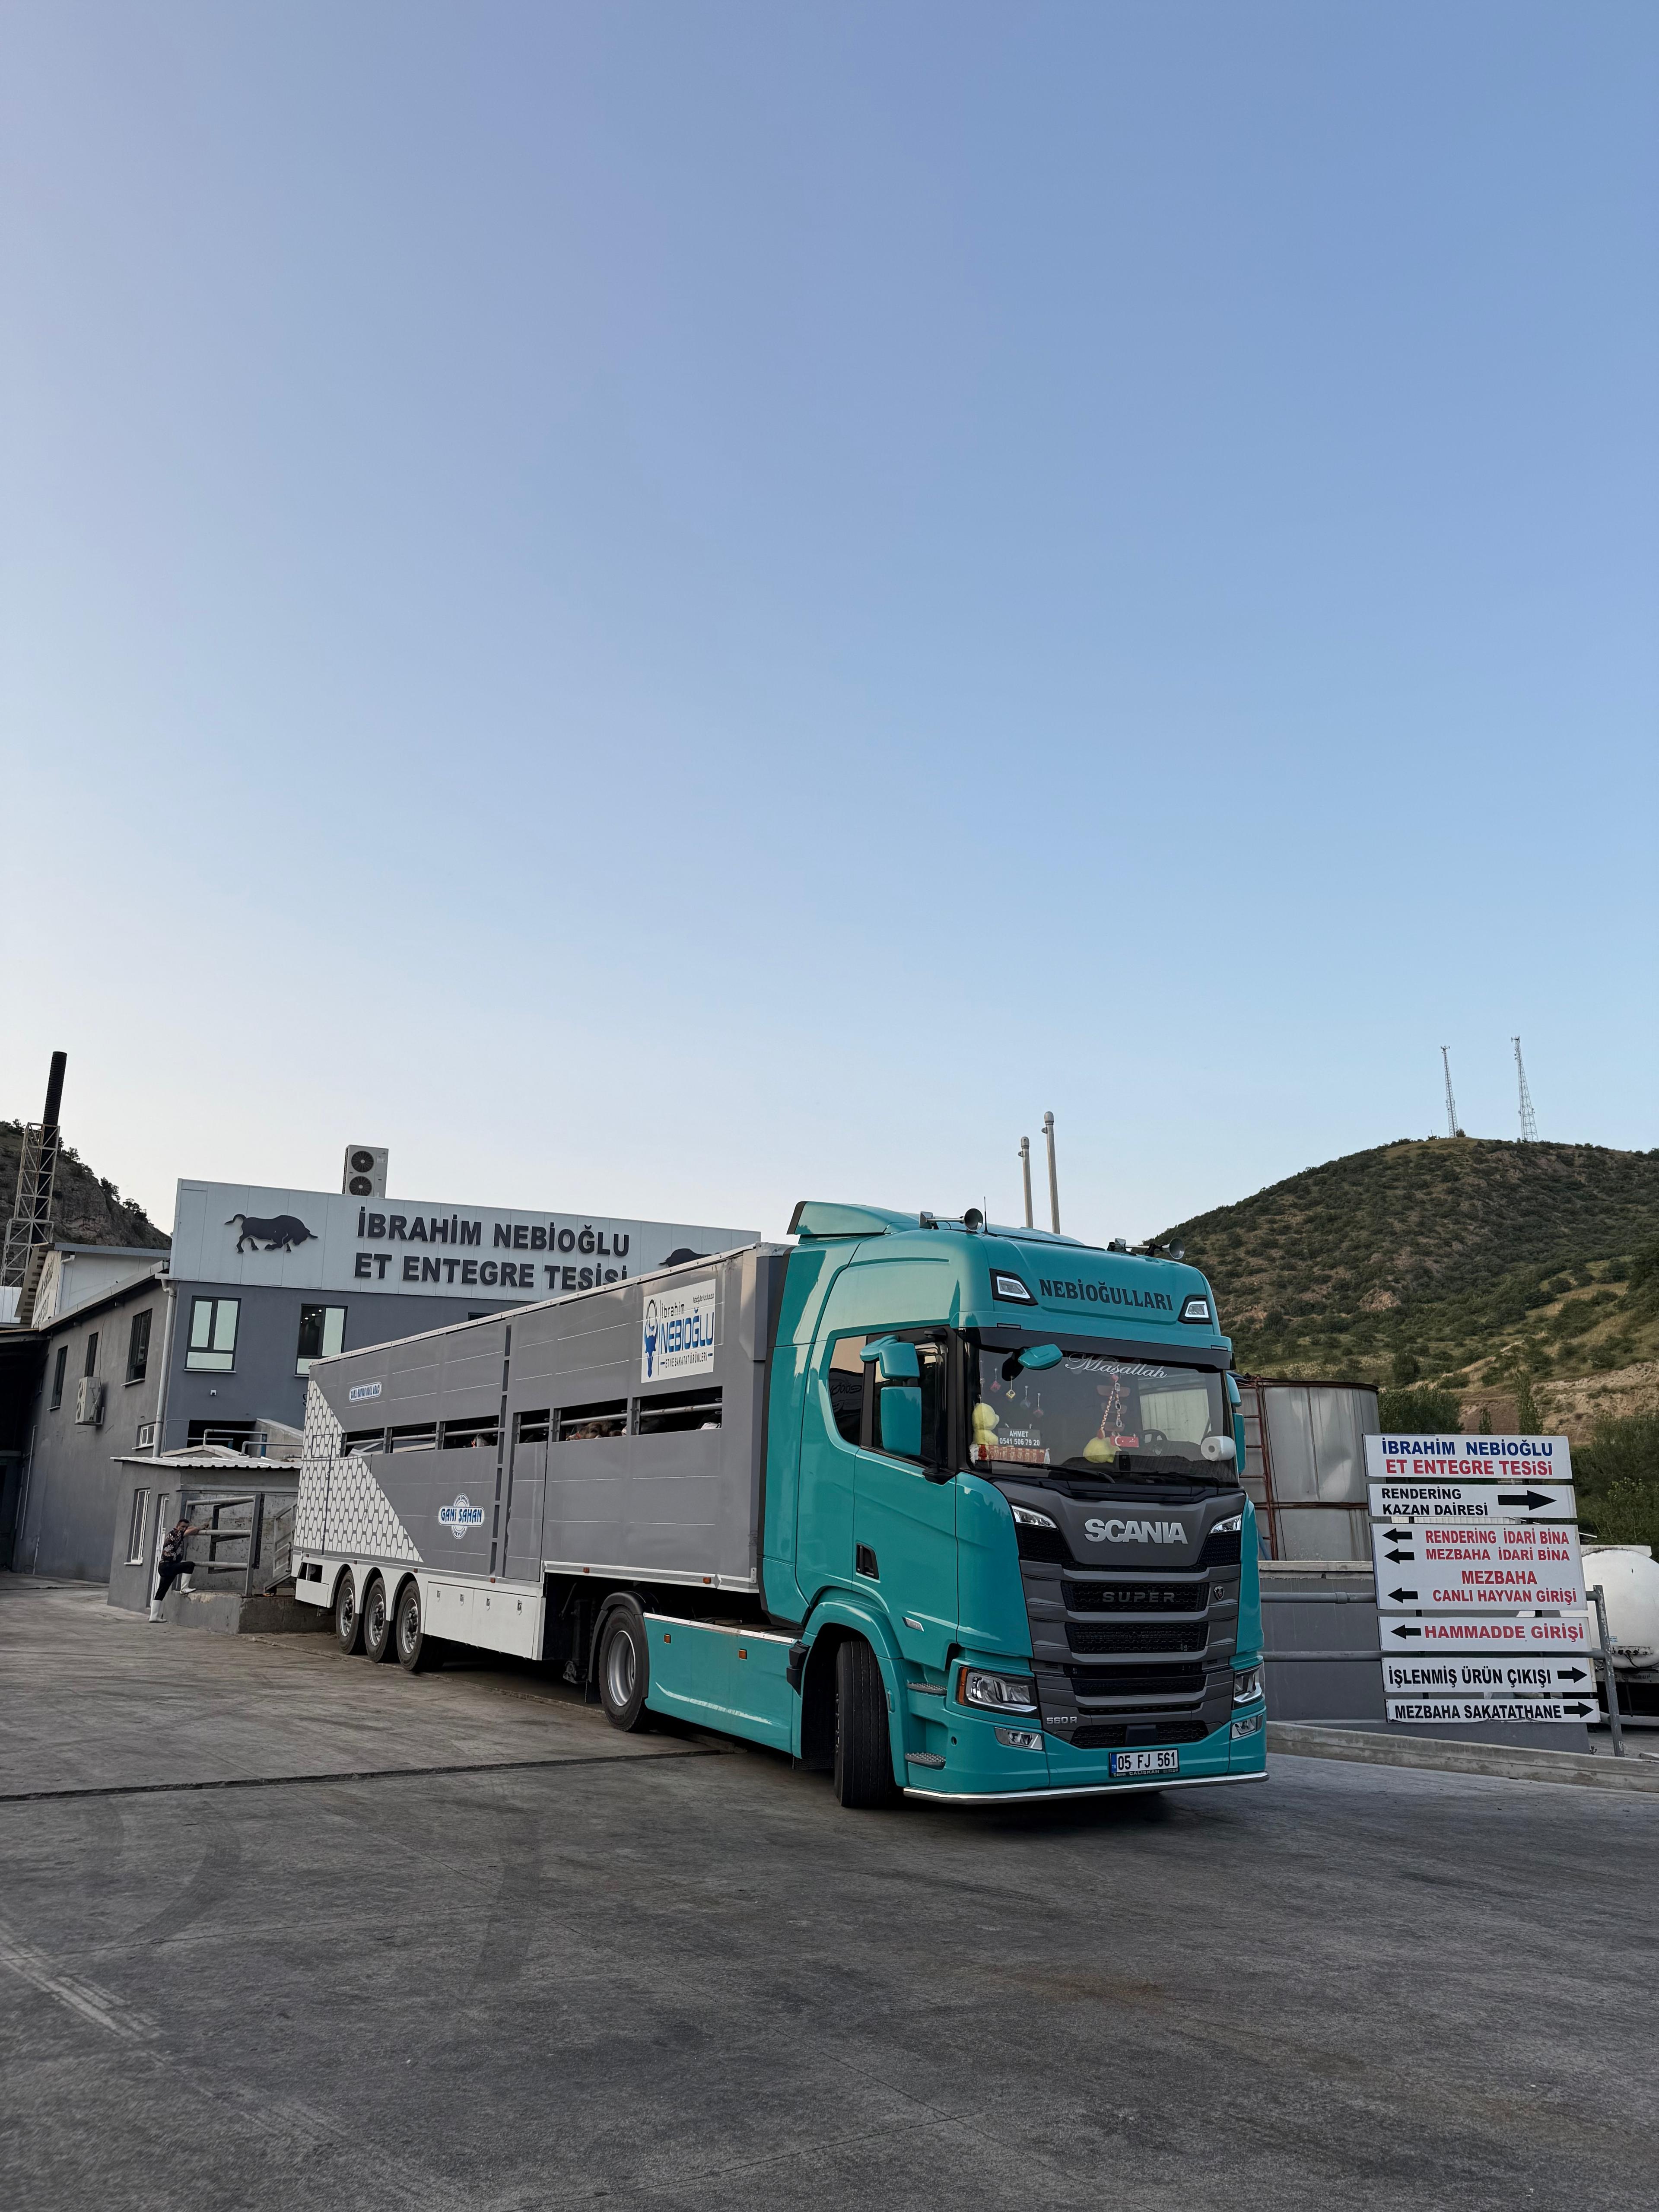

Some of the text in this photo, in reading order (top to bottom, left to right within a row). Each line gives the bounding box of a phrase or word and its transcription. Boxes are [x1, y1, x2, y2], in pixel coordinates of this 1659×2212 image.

[357, 1206, 629, 1257] İBRAHİM NEBİOĞLU
[354, 1252, 392, 1279] ET
[403, 1255, 534, 1287] ENTEGRE
[1039, 1279, 1174, 1311] NEBİOĞULLARI
[665, 1359, 669, 1368] ET
[670, 1357, 674, 1367] VE
[675, 1355, 690, 1366] SAKATAT
[1382, 1437, 1553, 1456] İBRAHİM NEBİOĞLU
[1386, 1459, 1407, 1474] ET
[1413, 1459, 1494, 1475] ENTEGRE
[1382, 1486, 1462, 1499] RENDERİNG
[1382, 1502, 1488, 1516] KAZAN DAİRESİ
[1084, 1519, 1188, 1544] SCANIA
[1426, 1527, 1570, 1545] RENDERİNG İDARİ BİNA
[1426, 1547, 1570, 1561] MEZBAHA İDARİ BİNA
[1462, 1570, 1538, 1585] MEZBAHA
[1102, 1592, 1175, 1602] SUPER
[1433, 1587, 1577, 1605] CANLI HAYVAN GİRİŞİ
[1424, 1623, 1584, 1642] HAMMADDE GİRİŞİ
[1389, 1665, 1551, 1688] İŞLENMİŞ ÜRÜN ÇIKIŞI
[1395, 1705, 1562, 1719] MEZBAHA SAKATATHANE
[1118, 1752, 1175, 1770] 05 FJ 561
